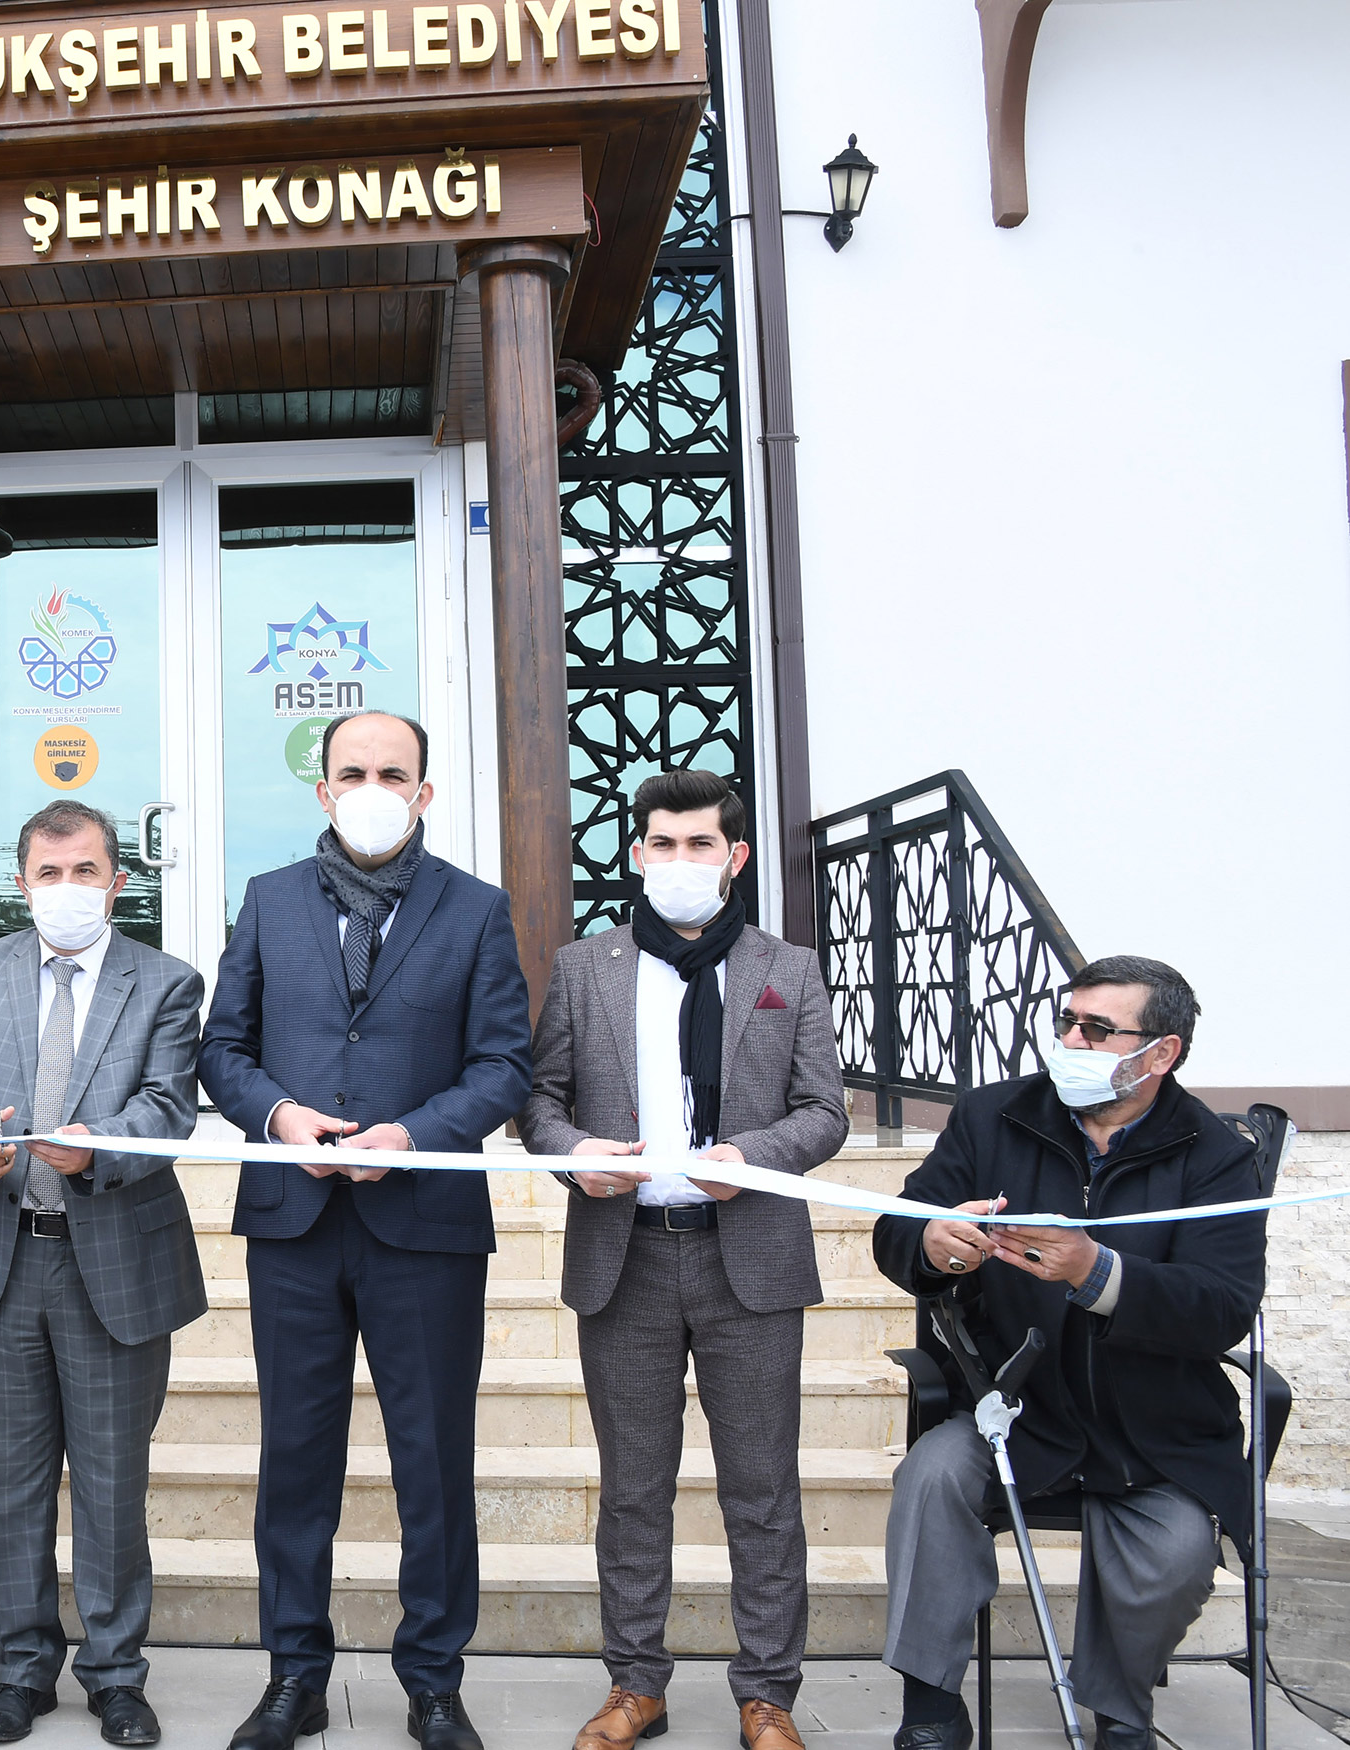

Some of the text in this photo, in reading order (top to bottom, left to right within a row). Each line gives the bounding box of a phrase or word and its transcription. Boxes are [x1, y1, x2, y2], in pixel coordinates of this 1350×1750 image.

[22, 165, 221, 254] ŞEHİR
[241, 147, 502, 229] KONAĞI
[61, 629, 94, 637] KOMEK
[298, 649, 338, 659] KONYA
[275, 681, 363, 709] ASEM
[13, 707, 41, 715] KONYA
[77, 706, 121, 714] EDİNDİRME
[309, 726, 327, 736] HES
[44, 739, 87, 747] MASKESİZ
[47, 750, 86, 758] GİRİLMEZ
[296, 768, 316, 777] Hayat
